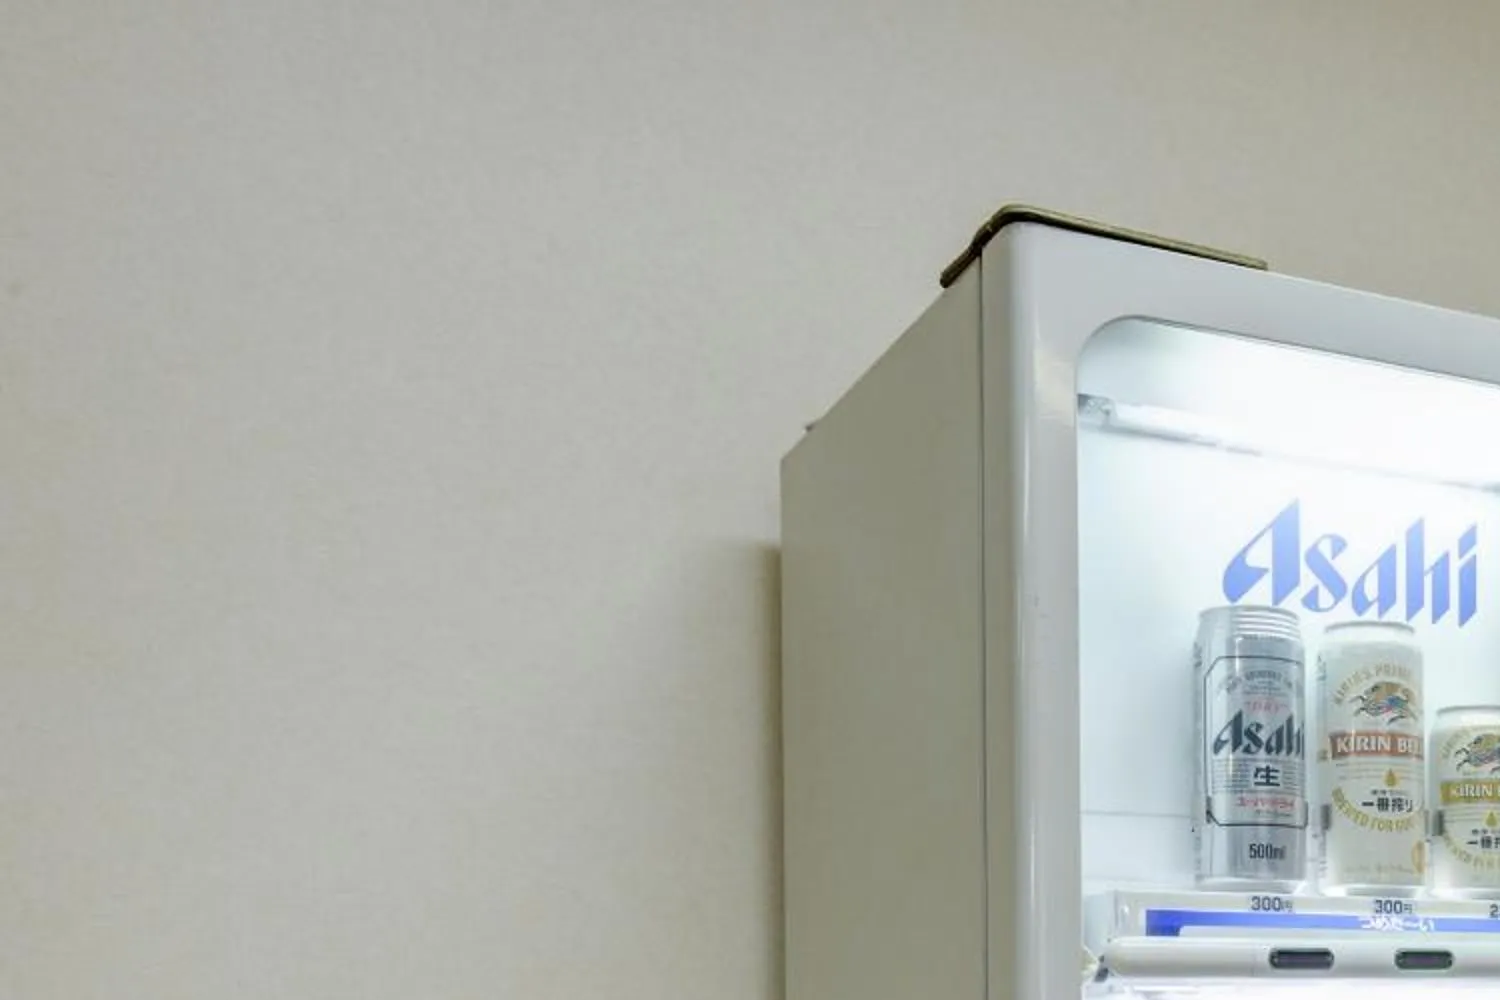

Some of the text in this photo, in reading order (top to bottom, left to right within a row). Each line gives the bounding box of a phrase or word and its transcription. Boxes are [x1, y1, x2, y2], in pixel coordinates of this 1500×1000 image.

[1222, 499, 1477, 628] Asahi
[1337, 735, 1392, 754] KIRIN
[1398, 737, 1421, 755] BEE
[1253, 765, 1281, 787] 生
[1450, 784, 1493, 798] KIRIN
